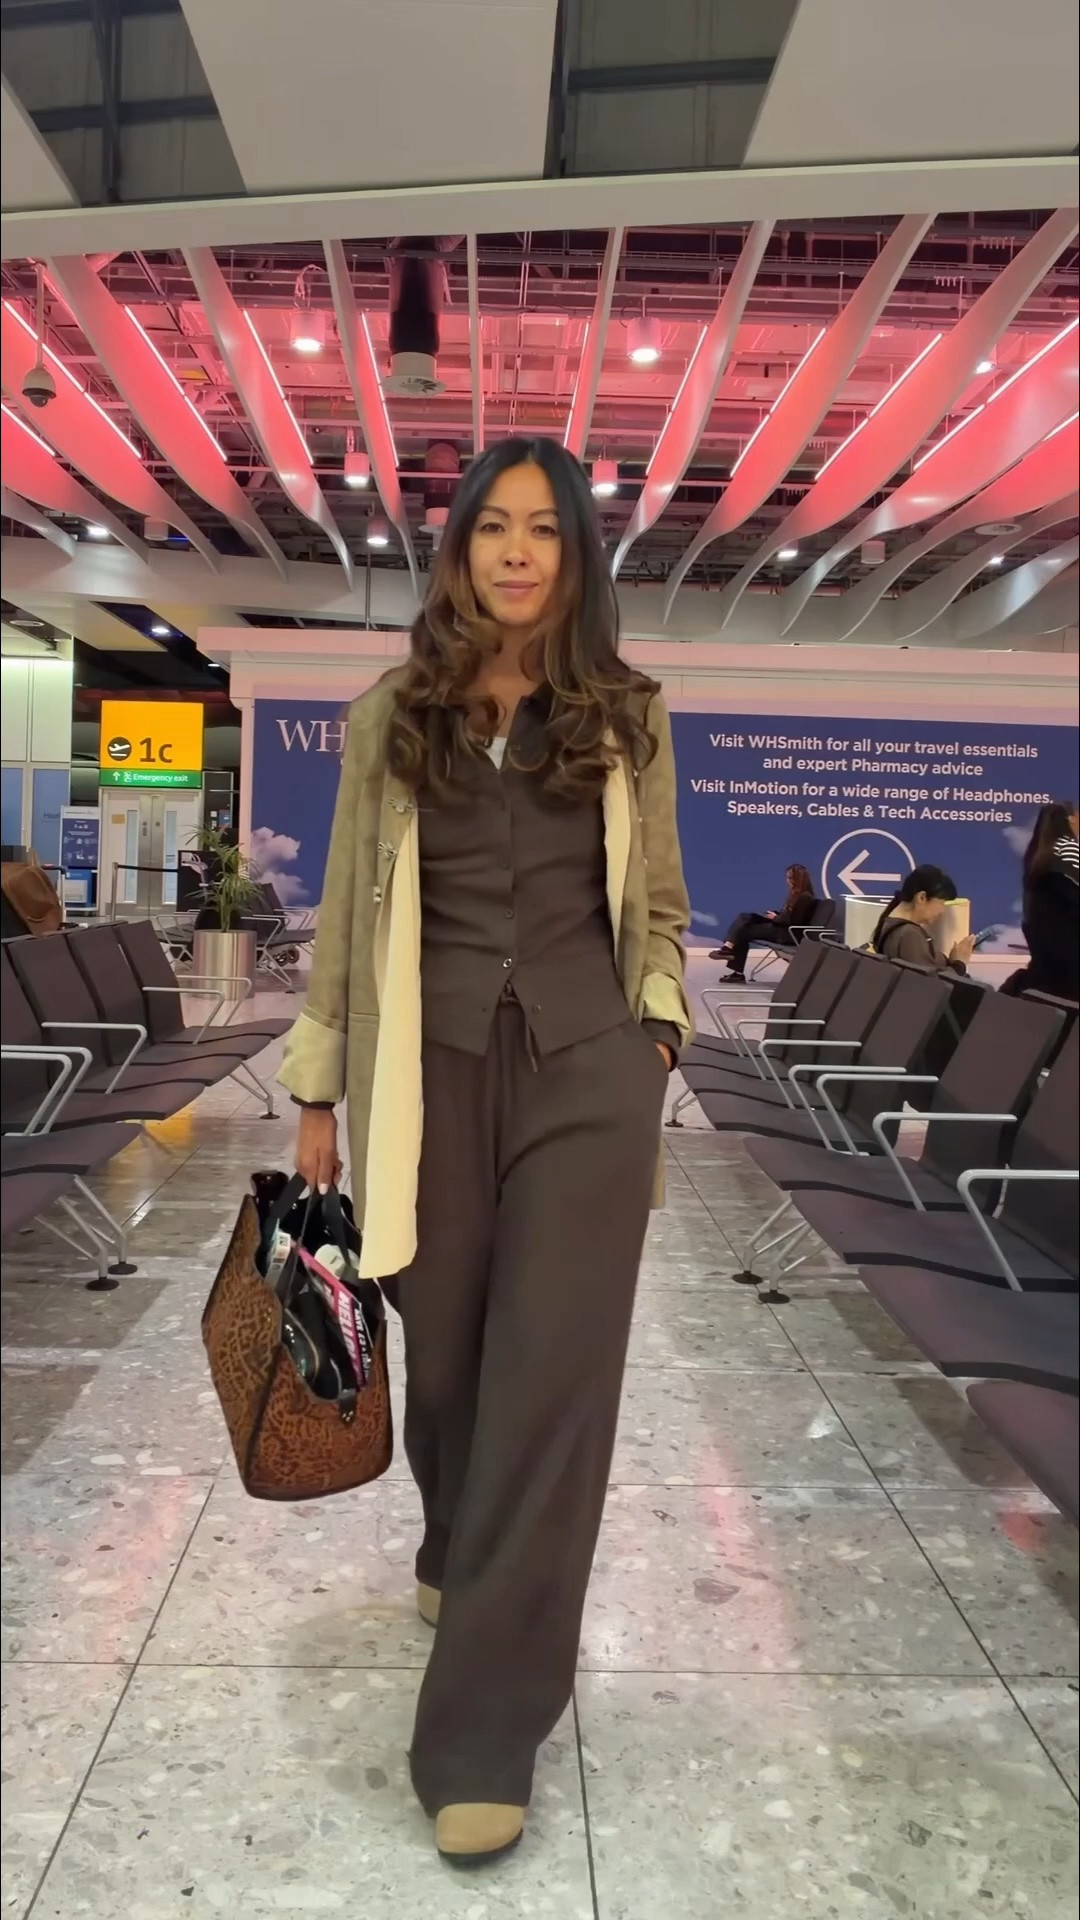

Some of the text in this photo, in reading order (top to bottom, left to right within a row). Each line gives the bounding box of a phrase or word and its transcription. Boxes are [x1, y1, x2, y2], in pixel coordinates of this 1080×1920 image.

[139, 737, 173, 763] 1c
[710, 734, 1038, 758] Visit WHSmith for all your travel essentials
[763, 756, 984, 776] and expert Pharmacy advice
[133, 774, 188, 783] Emergency exit
[690, 779, 726, 793] Visit
[729, 781, 799, 796] InMotion
[802, 782, 825, 796] for
[828, 786, 839, 797] a
[842, 785, 881, 798] wide
[884, 788, 929, 801] range
[932, 787, 950, 800] of
[727, 800, 1013, 822] Speakers, Cables & Tech Accessories
